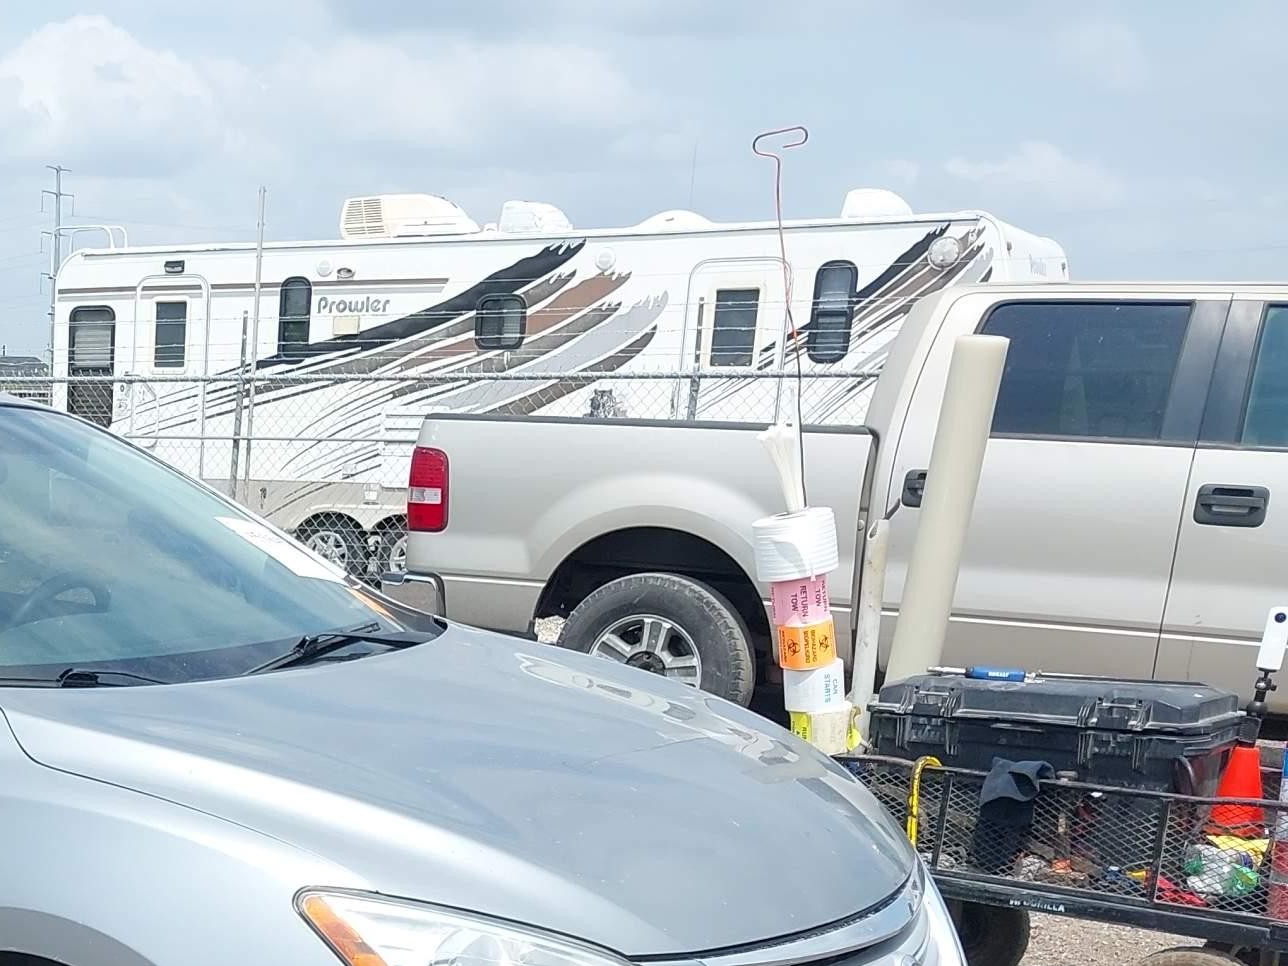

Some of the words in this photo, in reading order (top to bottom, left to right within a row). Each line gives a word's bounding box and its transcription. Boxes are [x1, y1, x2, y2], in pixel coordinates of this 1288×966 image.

[317, 296, 390, 313] Prowler
[791, 593, 799, 612] TOW
[800, 585, 809, 617] RETURN
